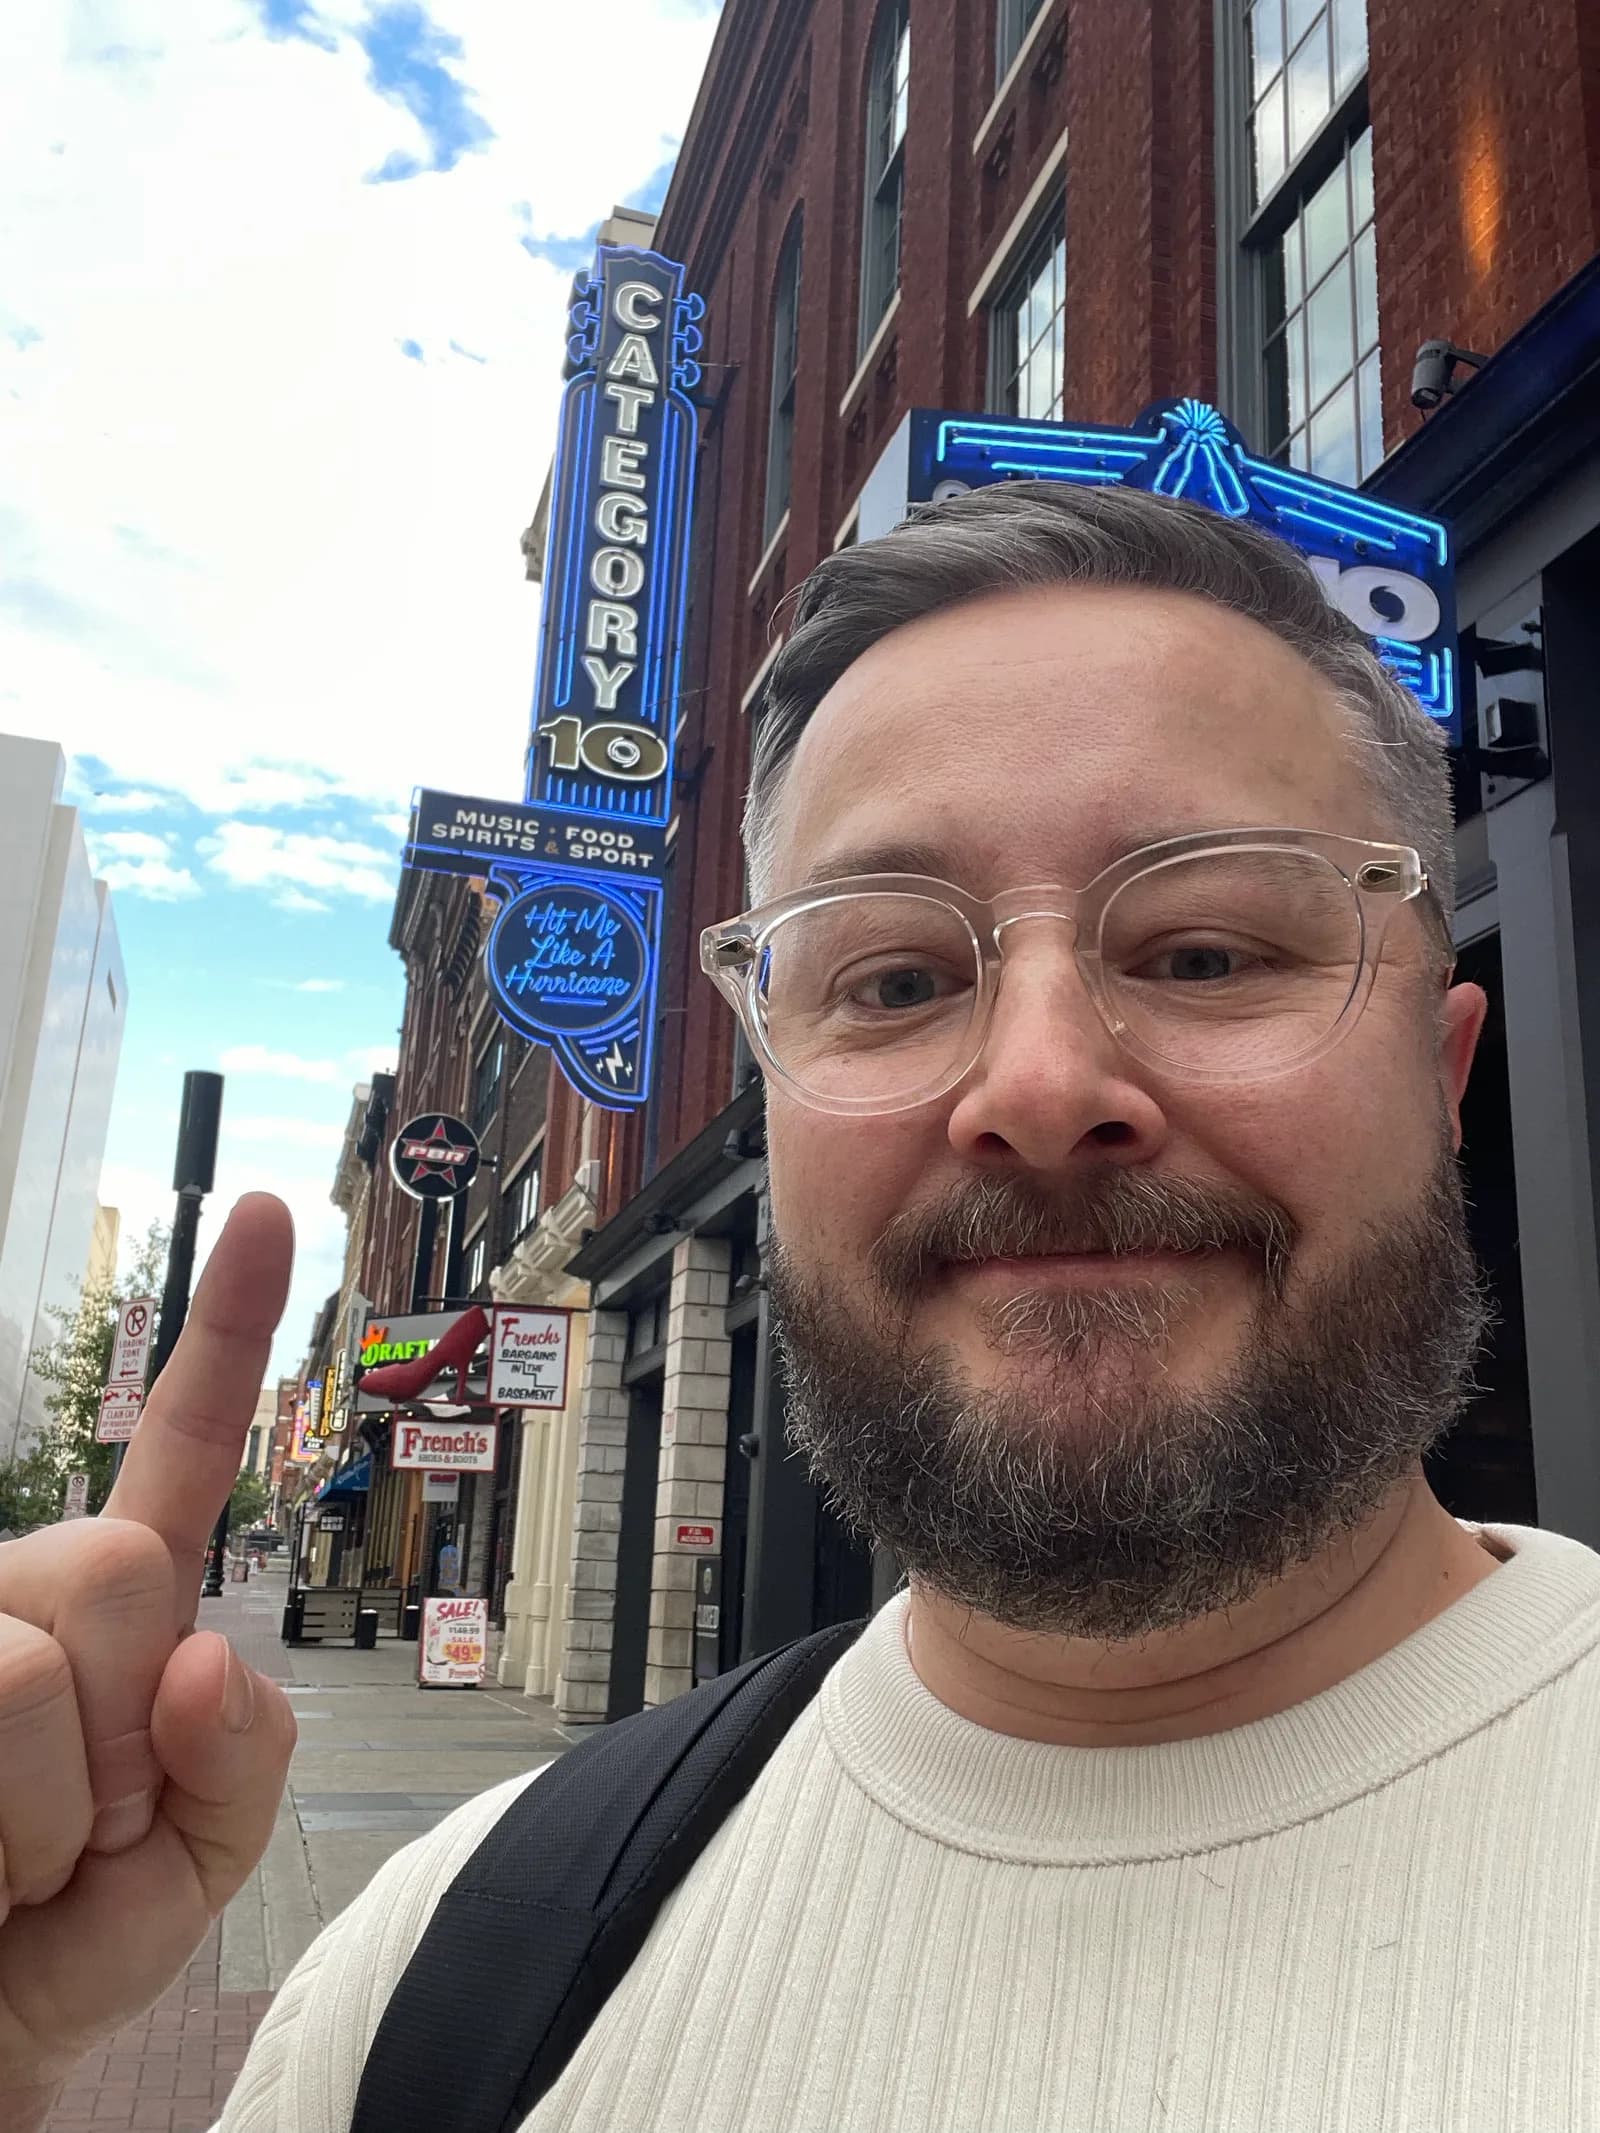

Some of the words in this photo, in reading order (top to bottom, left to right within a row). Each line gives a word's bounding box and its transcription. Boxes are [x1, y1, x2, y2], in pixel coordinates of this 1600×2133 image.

[581, 281, 662, 711] CATEGORY
[538, 716, 668, 781] 10
[456, 810, 540, 835] MUSIC
[565, 826, 634, 848] FOOD
[432, 823, 536, 851] SPIRITS
[544, 840, 560, 855] &
[569, 844, 654, 868] SPORT
[525, 902, 577, 935] Hit
[575, 903, 621, 937] Me
[525, 936, 586, 968] Like
[590, 937, 616, 970] A
[505, 965, 631, 996] Hurricane
[408, 1145, 465, 1162] PBR
[119, 1338, 146, 1349] LOADING
[122, 1348, 140, 1358] ZONE
[502, 1349, 557, 1361] BARGAINS
[511, 1364, 522, 1374] IN
[527, 1364, 544, 1373] THE
[498, 1387, 555, 1401] BASEMENT
[400, 1427, 487, 1459] French's
[418, 1454, 442, 1462] SHOES
[444, 1455, 452, 1463] &
[453, 1455, 478, 1464] BOOTS
[437, 1601, 479, 1620] SALE!
